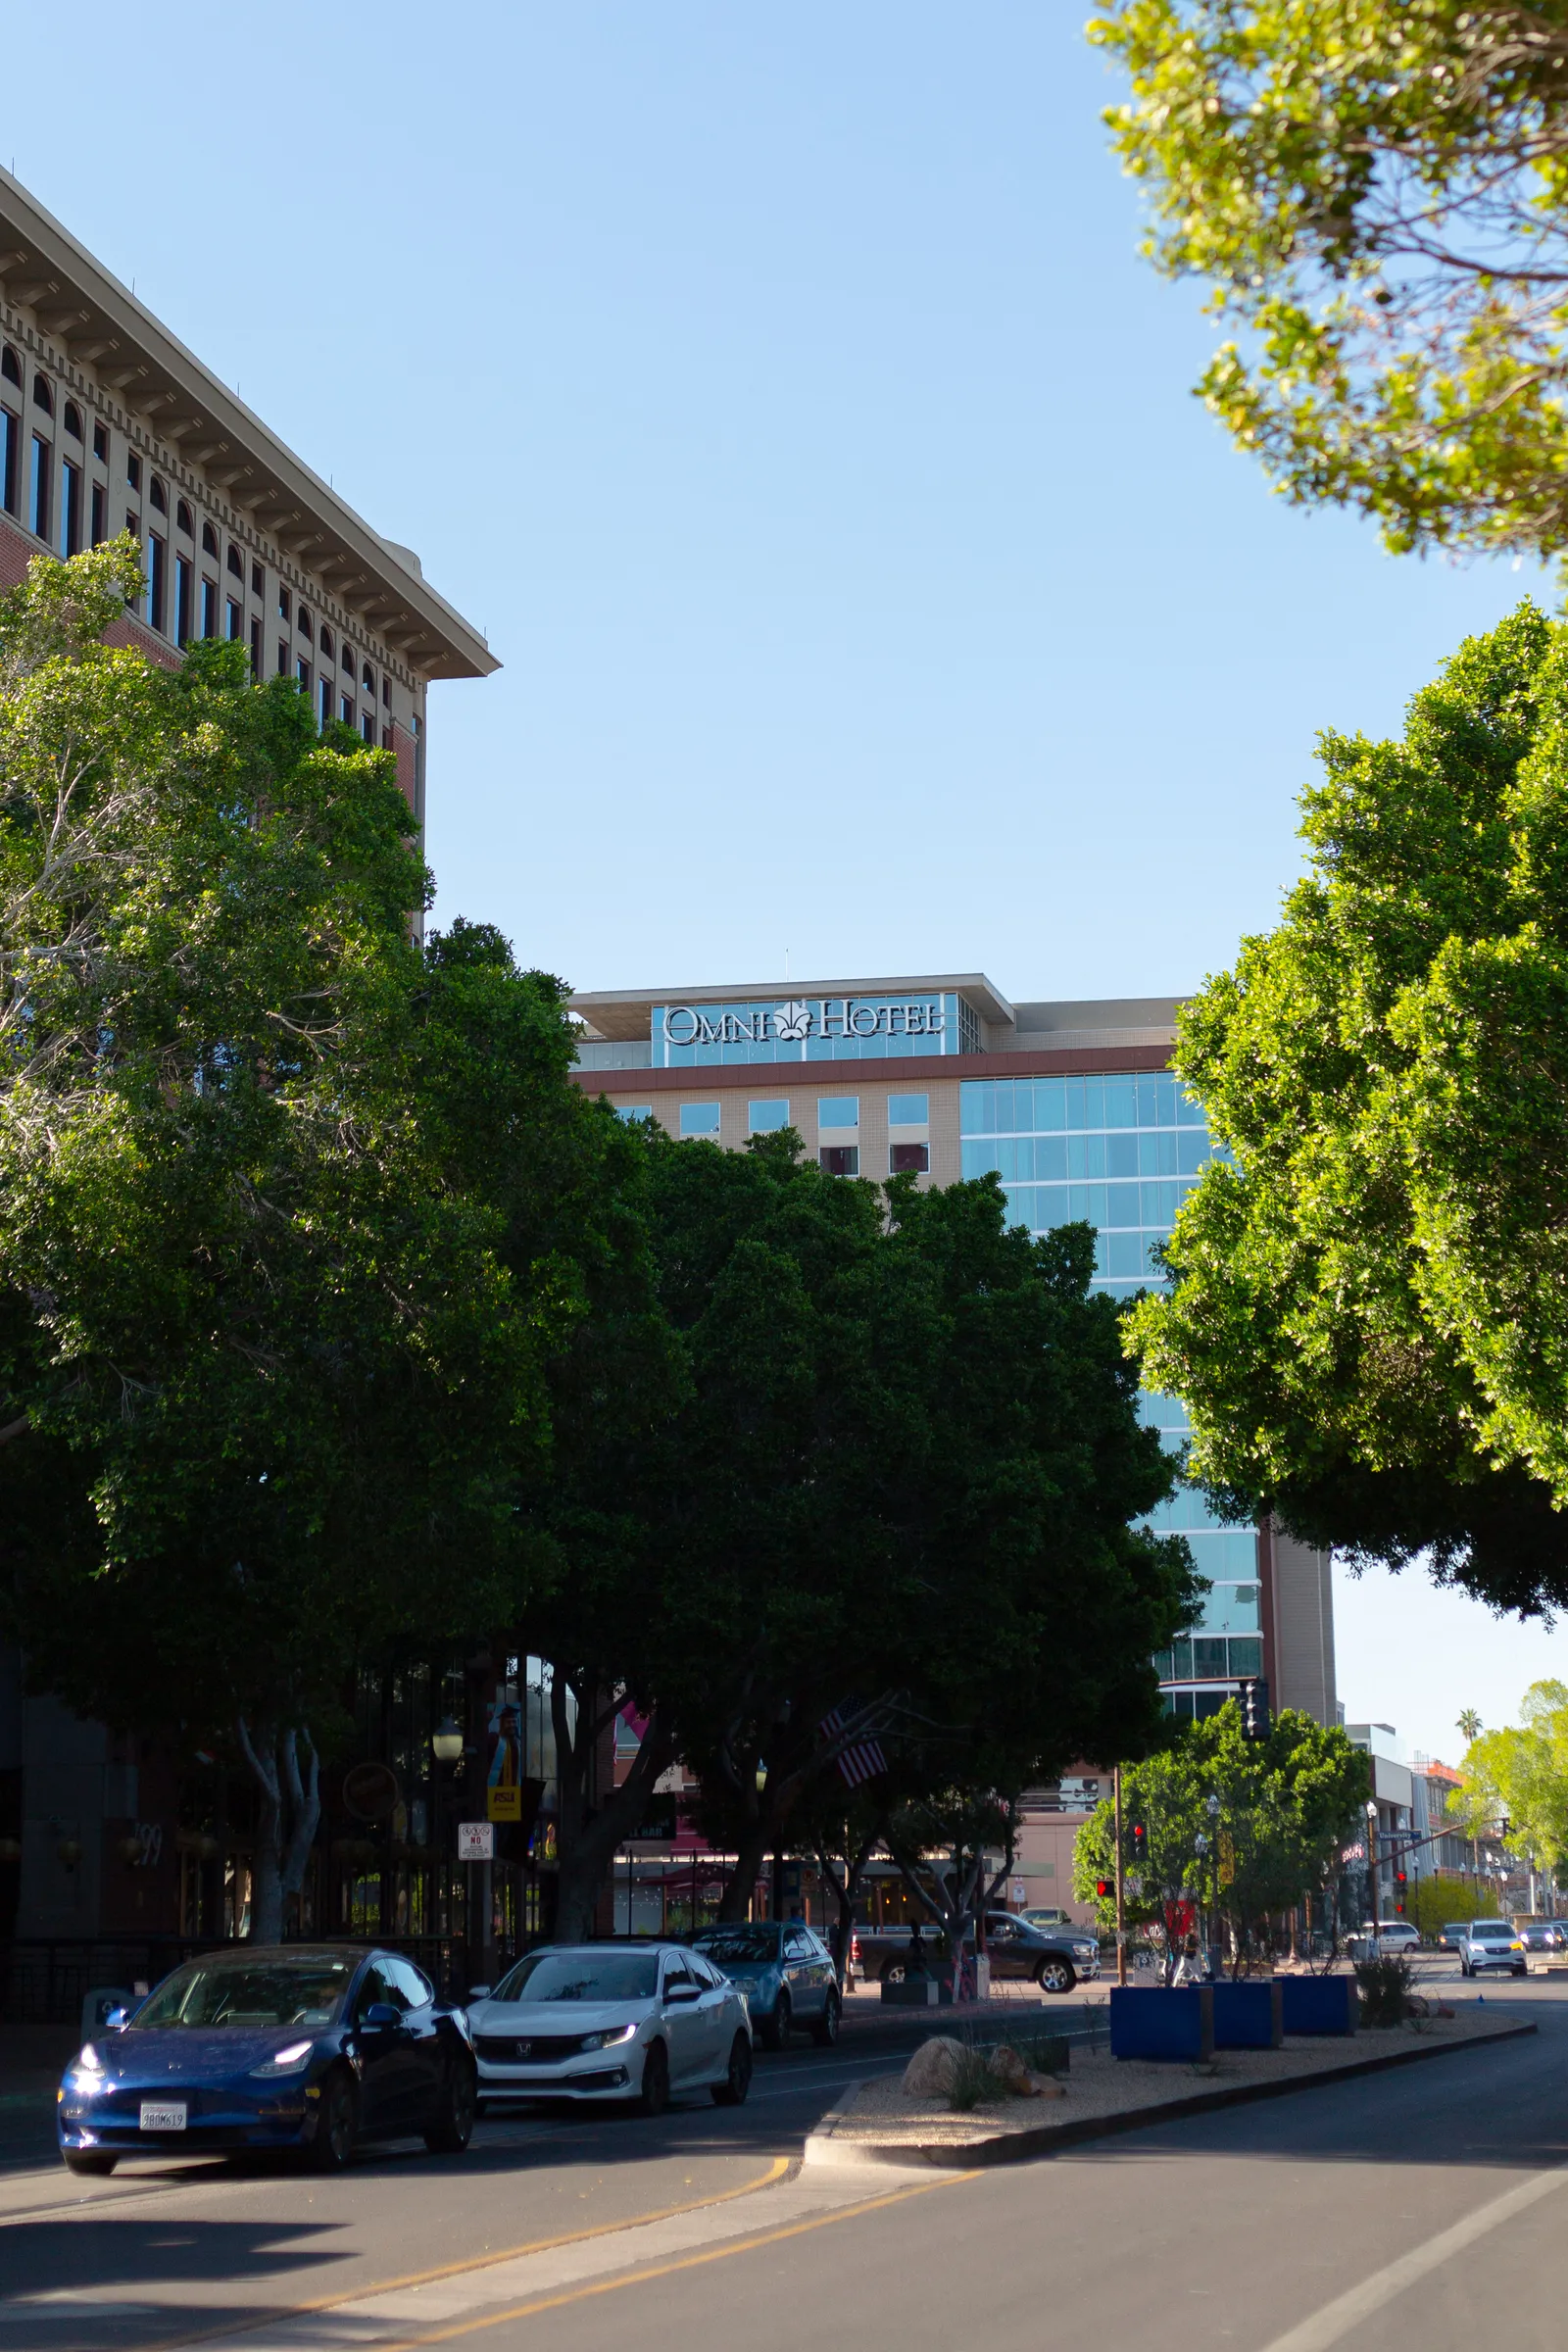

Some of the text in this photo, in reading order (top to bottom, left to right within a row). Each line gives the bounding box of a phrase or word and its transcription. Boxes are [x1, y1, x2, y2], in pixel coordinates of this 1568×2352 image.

[662, 999, 945, 1045] OMNI HOTEL
[494, 1791, 514, 1802] ASU
[470, 1836, 481, 1844] NO
